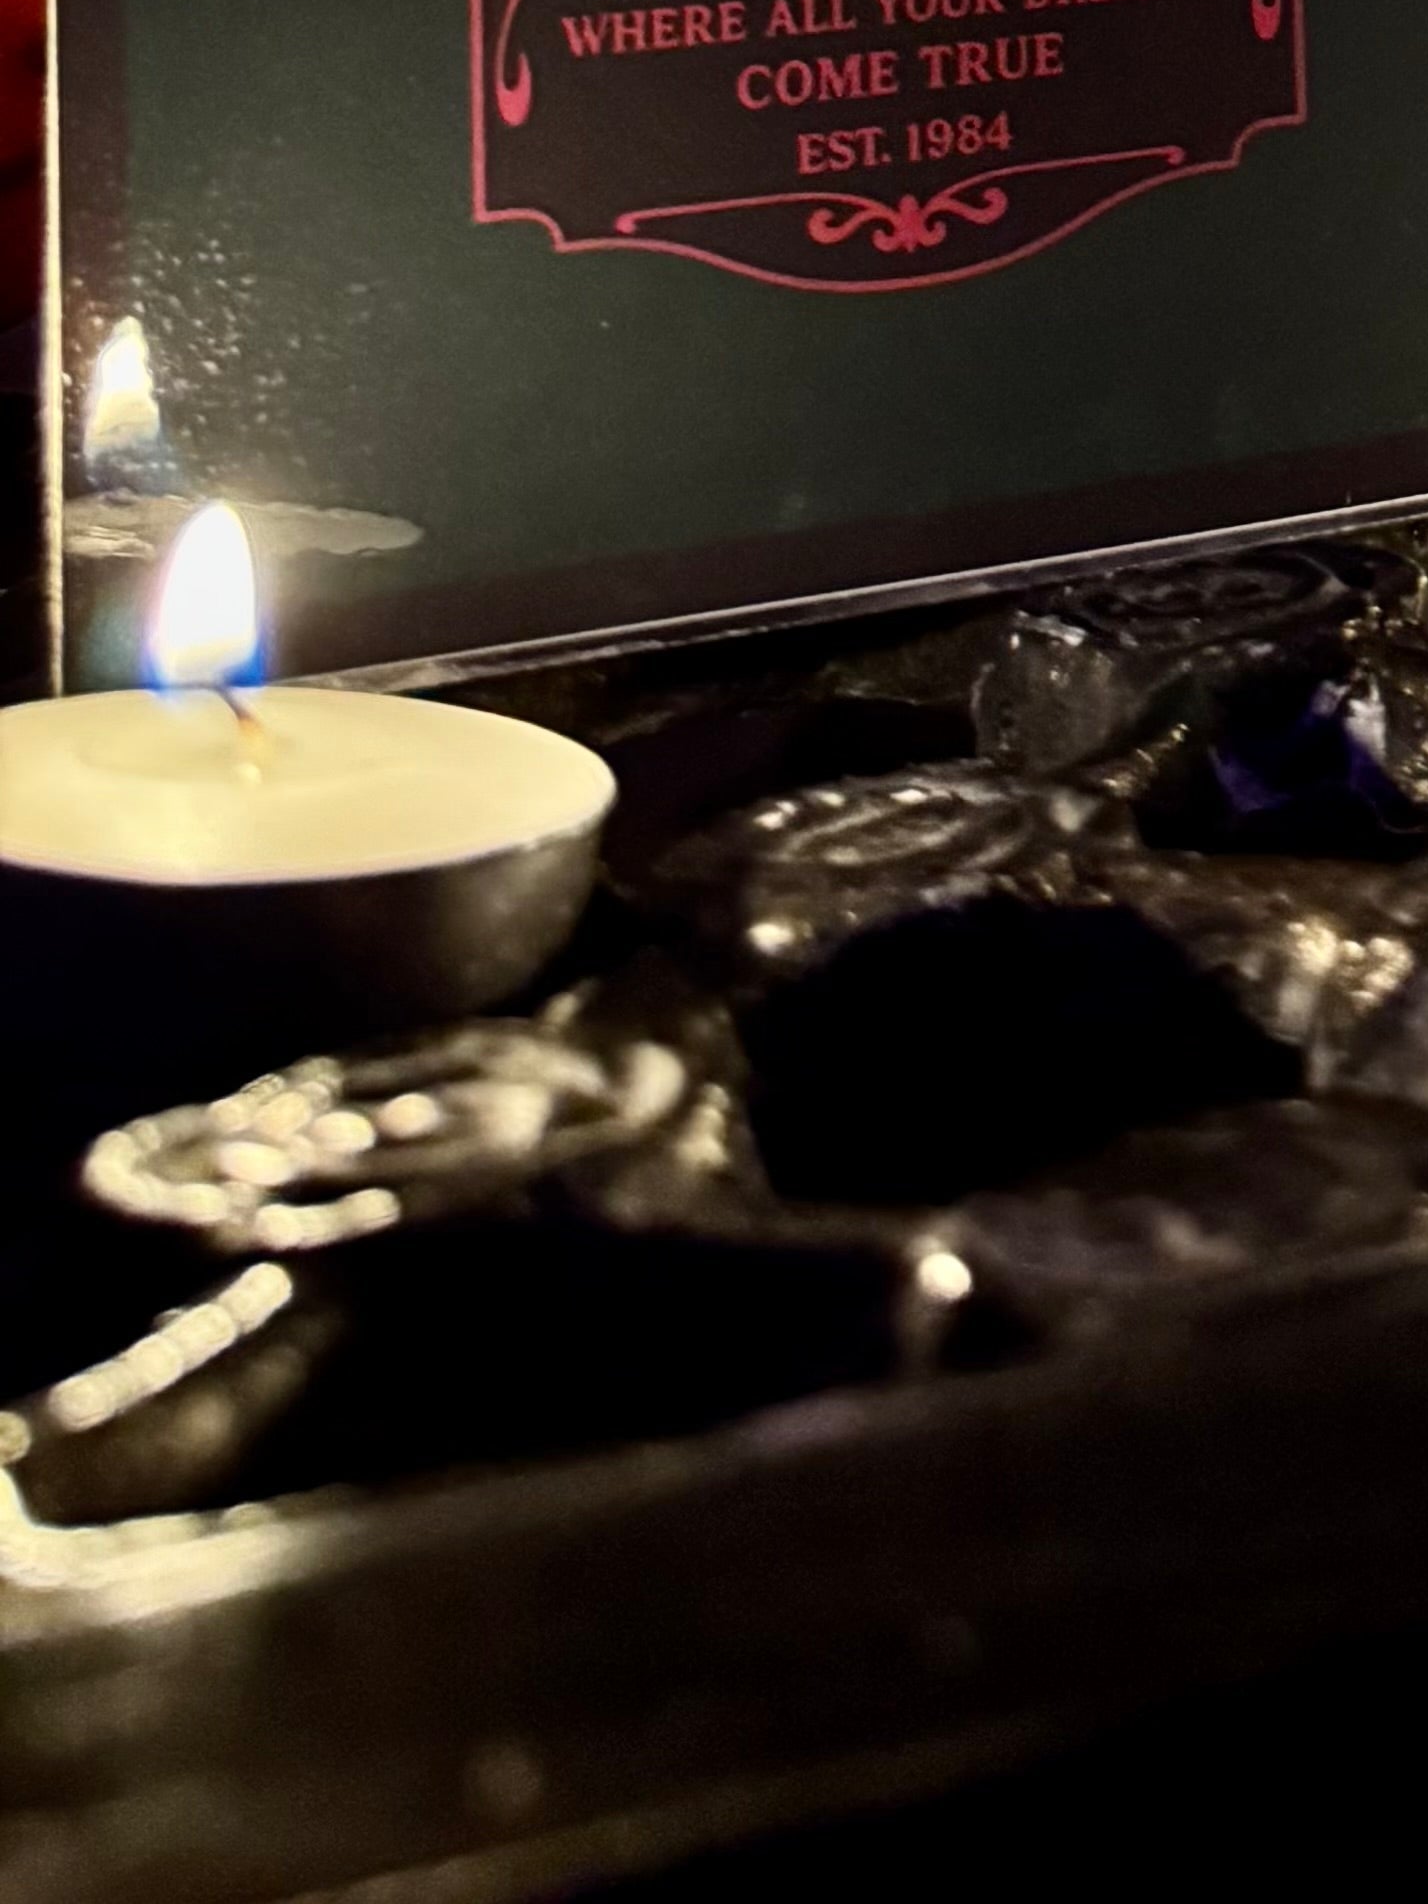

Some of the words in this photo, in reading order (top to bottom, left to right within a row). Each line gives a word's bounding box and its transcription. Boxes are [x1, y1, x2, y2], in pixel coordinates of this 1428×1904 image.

[560, 3, 745, 58] WHERE
[736, 51, 897, 110] COME
[918, 34, 1063, 88] TRUE
[796, 128, 891, 175] EST.
[905, 111, 1013, 165] 1984
